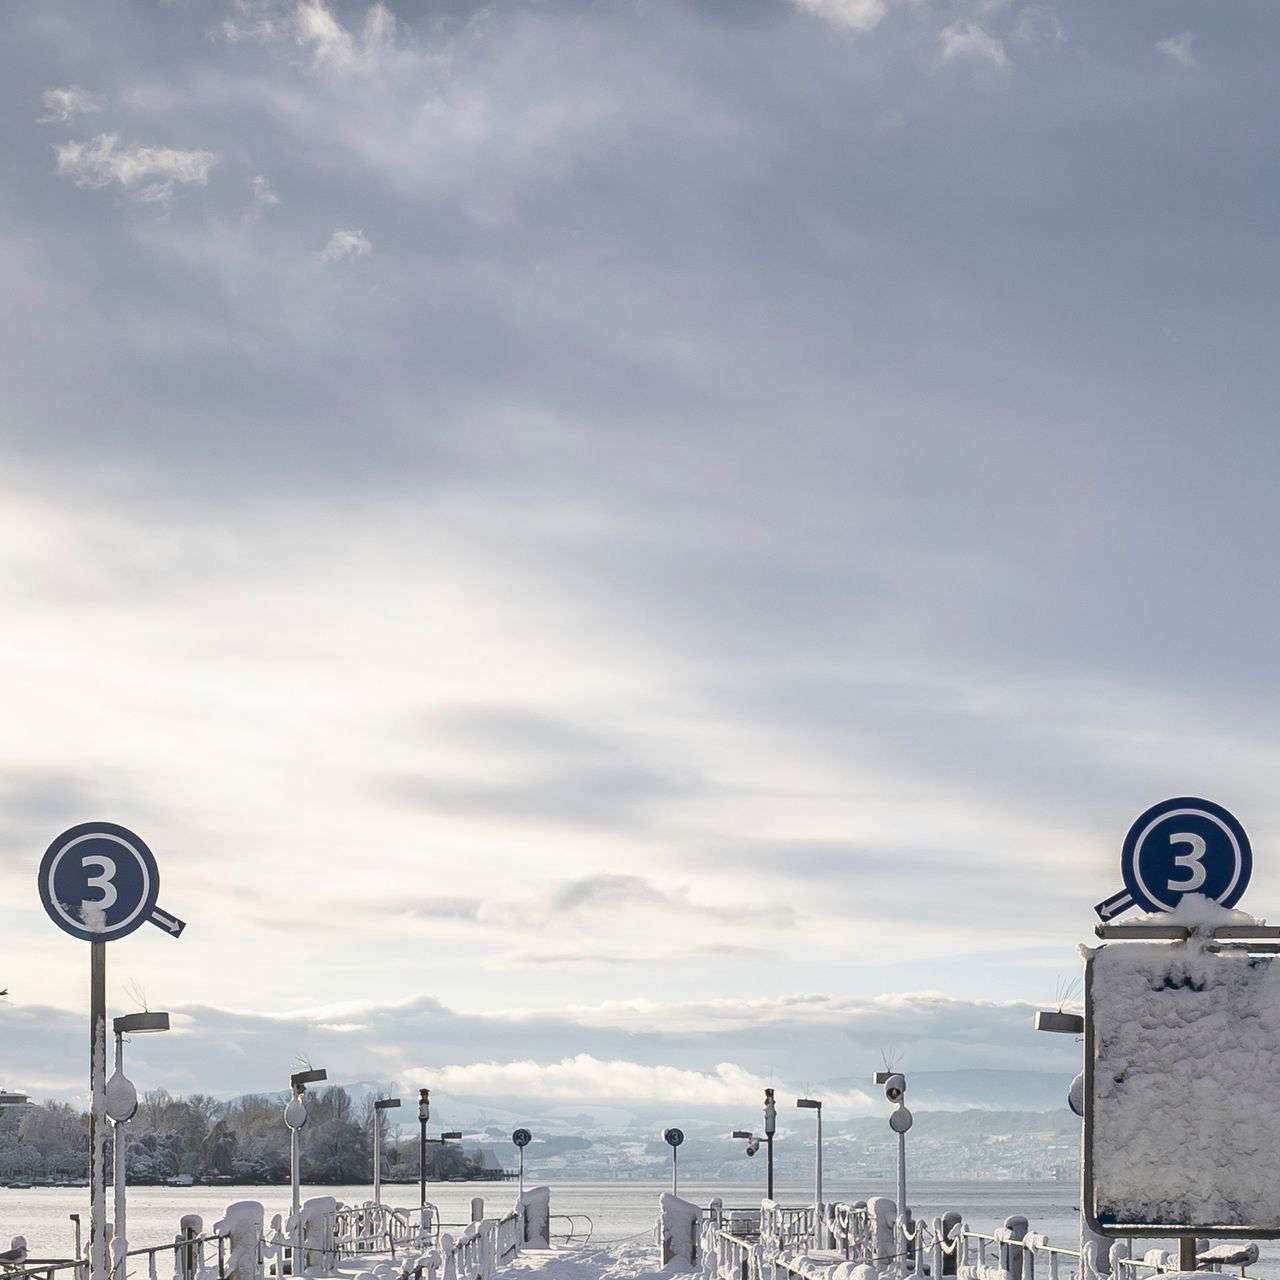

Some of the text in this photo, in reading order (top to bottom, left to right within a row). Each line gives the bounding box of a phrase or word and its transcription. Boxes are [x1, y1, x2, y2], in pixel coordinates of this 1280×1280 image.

[81, 855, 118, 911] 3
[1168, 833, 1207, 891] 3
[671, 1132, 679, 1143] 3
